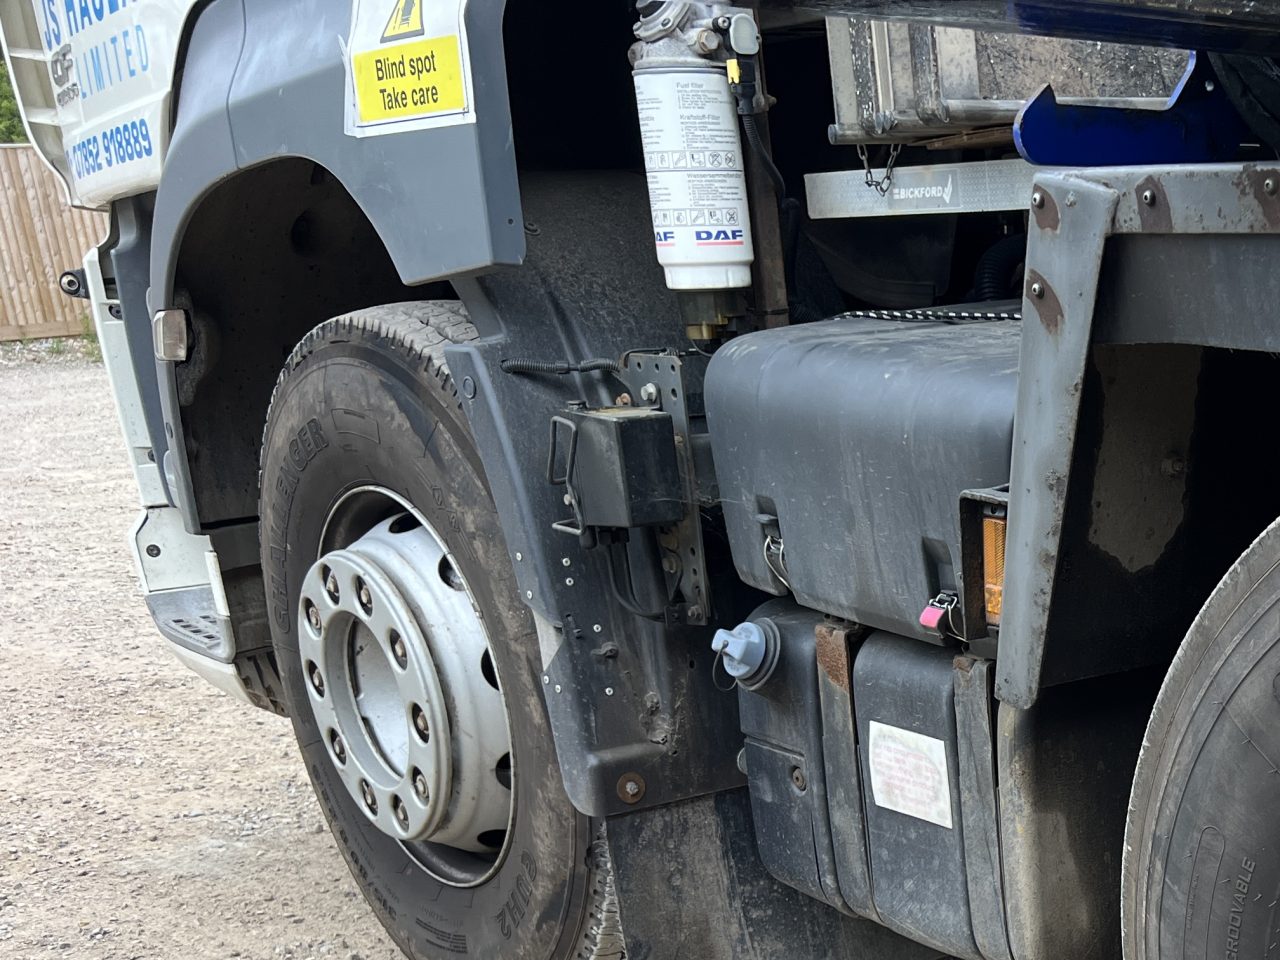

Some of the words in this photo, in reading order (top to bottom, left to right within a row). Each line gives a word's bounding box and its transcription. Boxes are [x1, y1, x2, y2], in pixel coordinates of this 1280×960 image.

[75, 25, 149, 99] LIMITED
[375, 54, 406, 82] Blind
[409, 50, 437, 81] spot
[379, 87, 408, 111] Take
[411, 85, 439, 107] care
[102, 118, 153, 167] 918889
[900, 186, 943, 200] BICKFORD
[655, 231, 675, 242] AF
[695, 229, 744, 241] DAF
